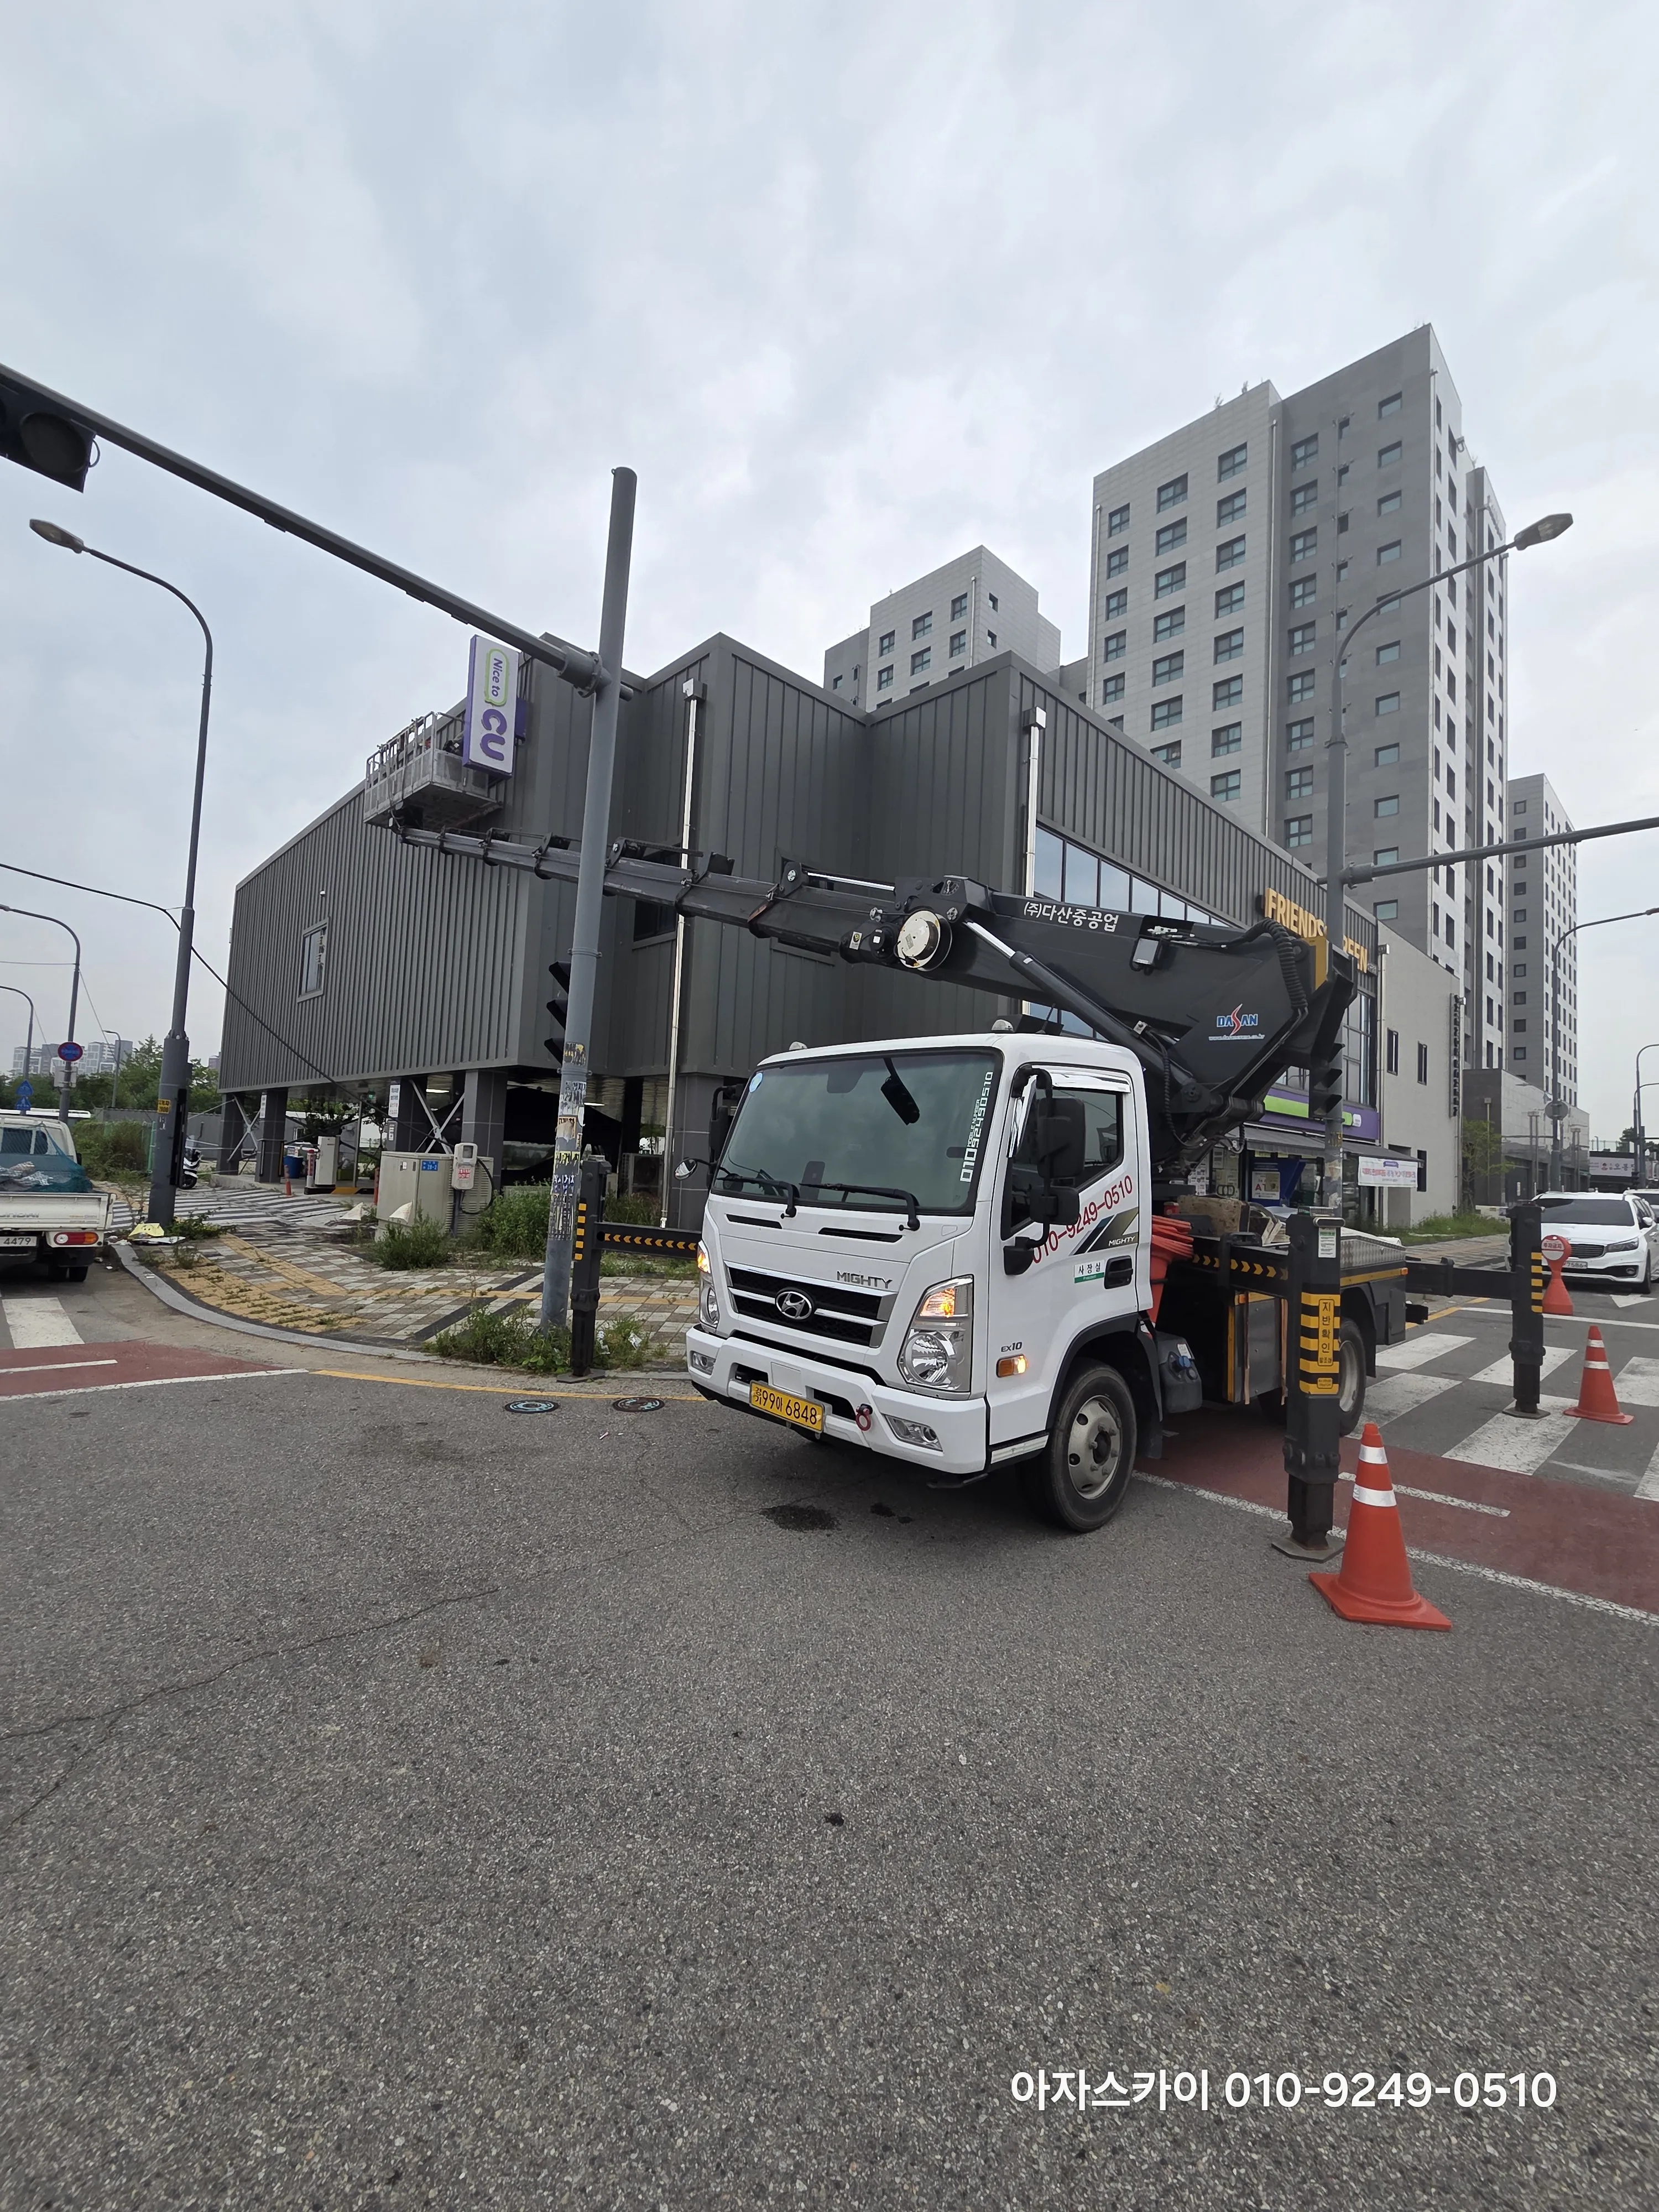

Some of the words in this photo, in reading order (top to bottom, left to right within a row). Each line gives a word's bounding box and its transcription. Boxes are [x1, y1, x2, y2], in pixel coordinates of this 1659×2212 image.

[492, 658, 503, 684] Nice
[491, 685, 499, 697] to
[480, 708, 507, 761] CU
[1024, 902, 1119, 932] (주)다산중공업
[1217, 1004, 1258, 1036] DASAN
[1108, 1236, 1135, 1246] MIGHTY
[837, 1270, 893, 1289] MIGHTY
[1001, 1342, 1022, 1353] EX10
[785, 1399, 817, 1425] 6848
